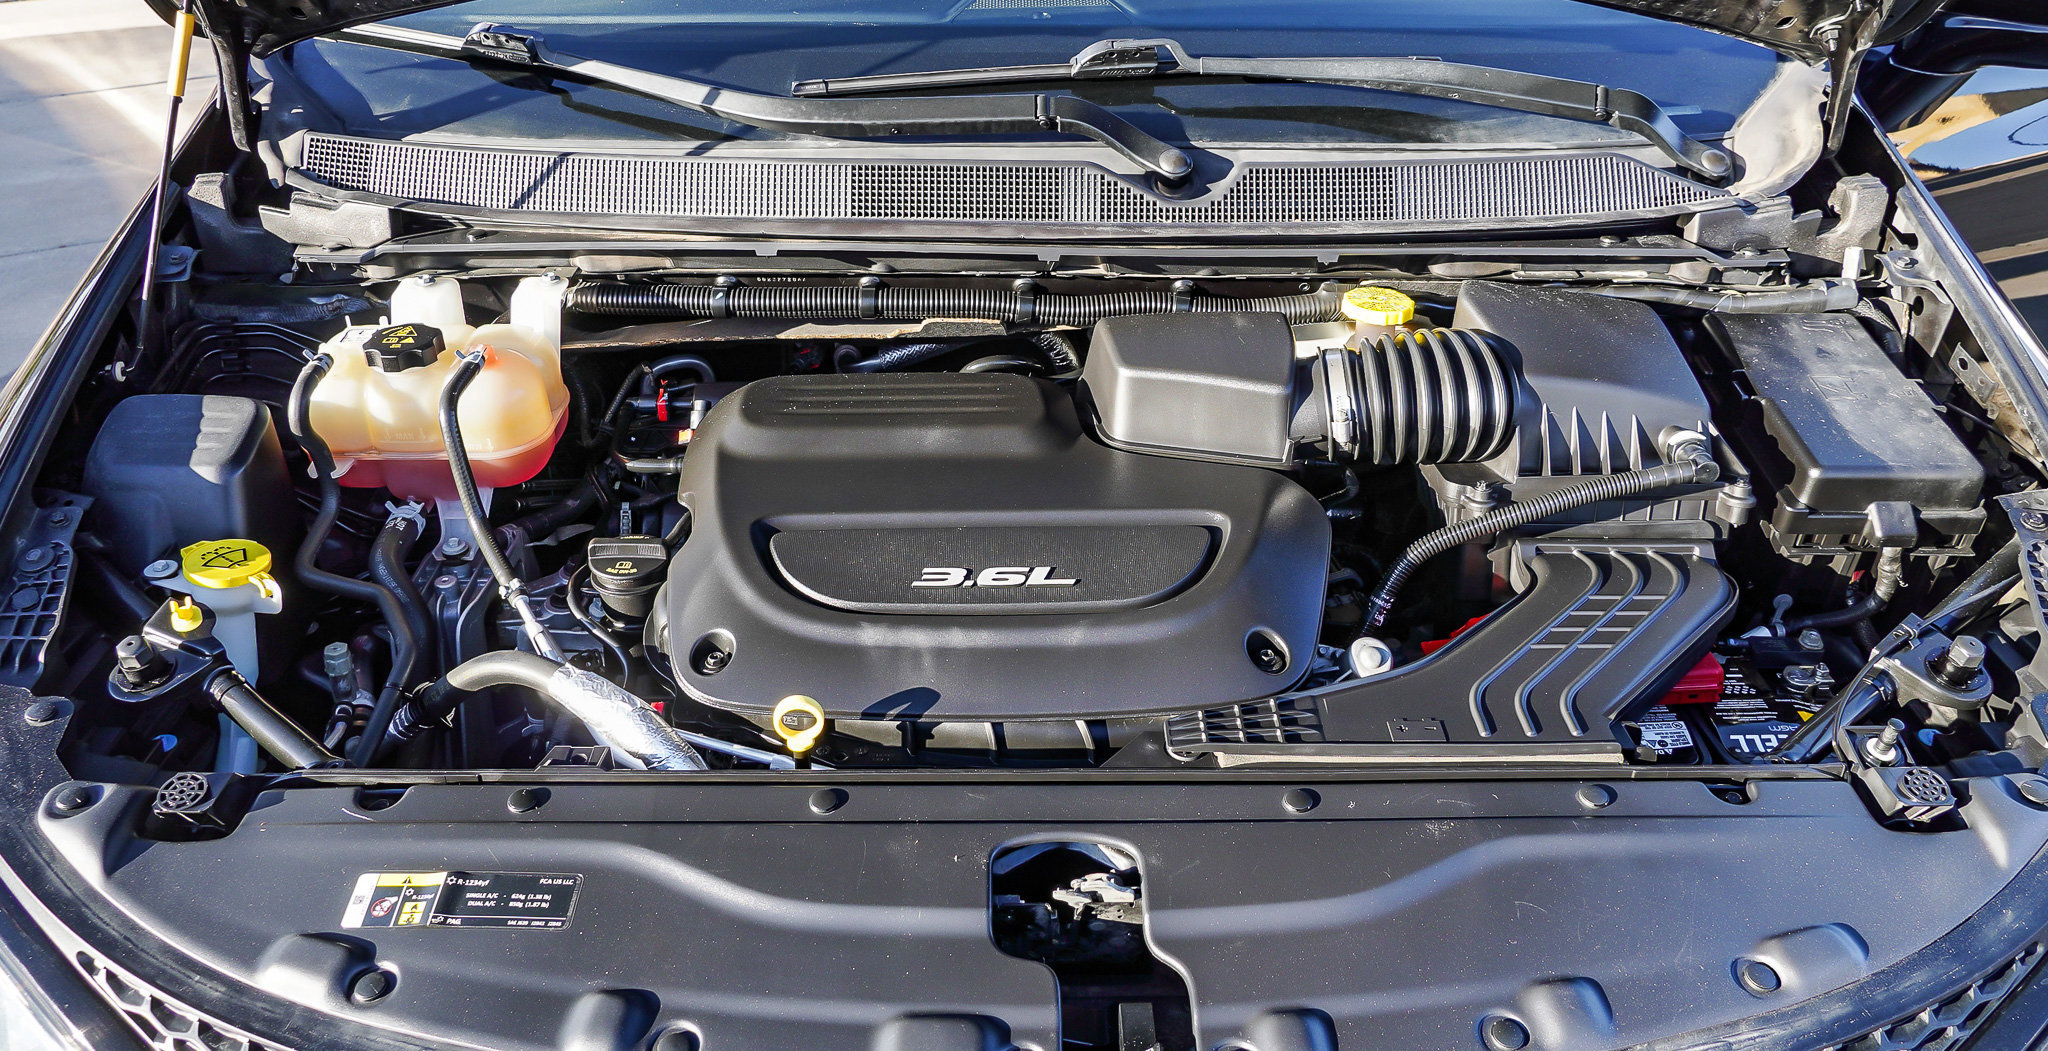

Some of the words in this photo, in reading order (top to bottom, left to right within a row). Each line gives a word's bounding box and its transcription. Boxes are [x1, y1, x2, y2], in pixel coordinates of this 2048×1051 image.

[911, 567, 1077, 588] 3.6L
[1730, 735, 1789, 752] ELL
[457, 879, 490, 887] R-1234yf
